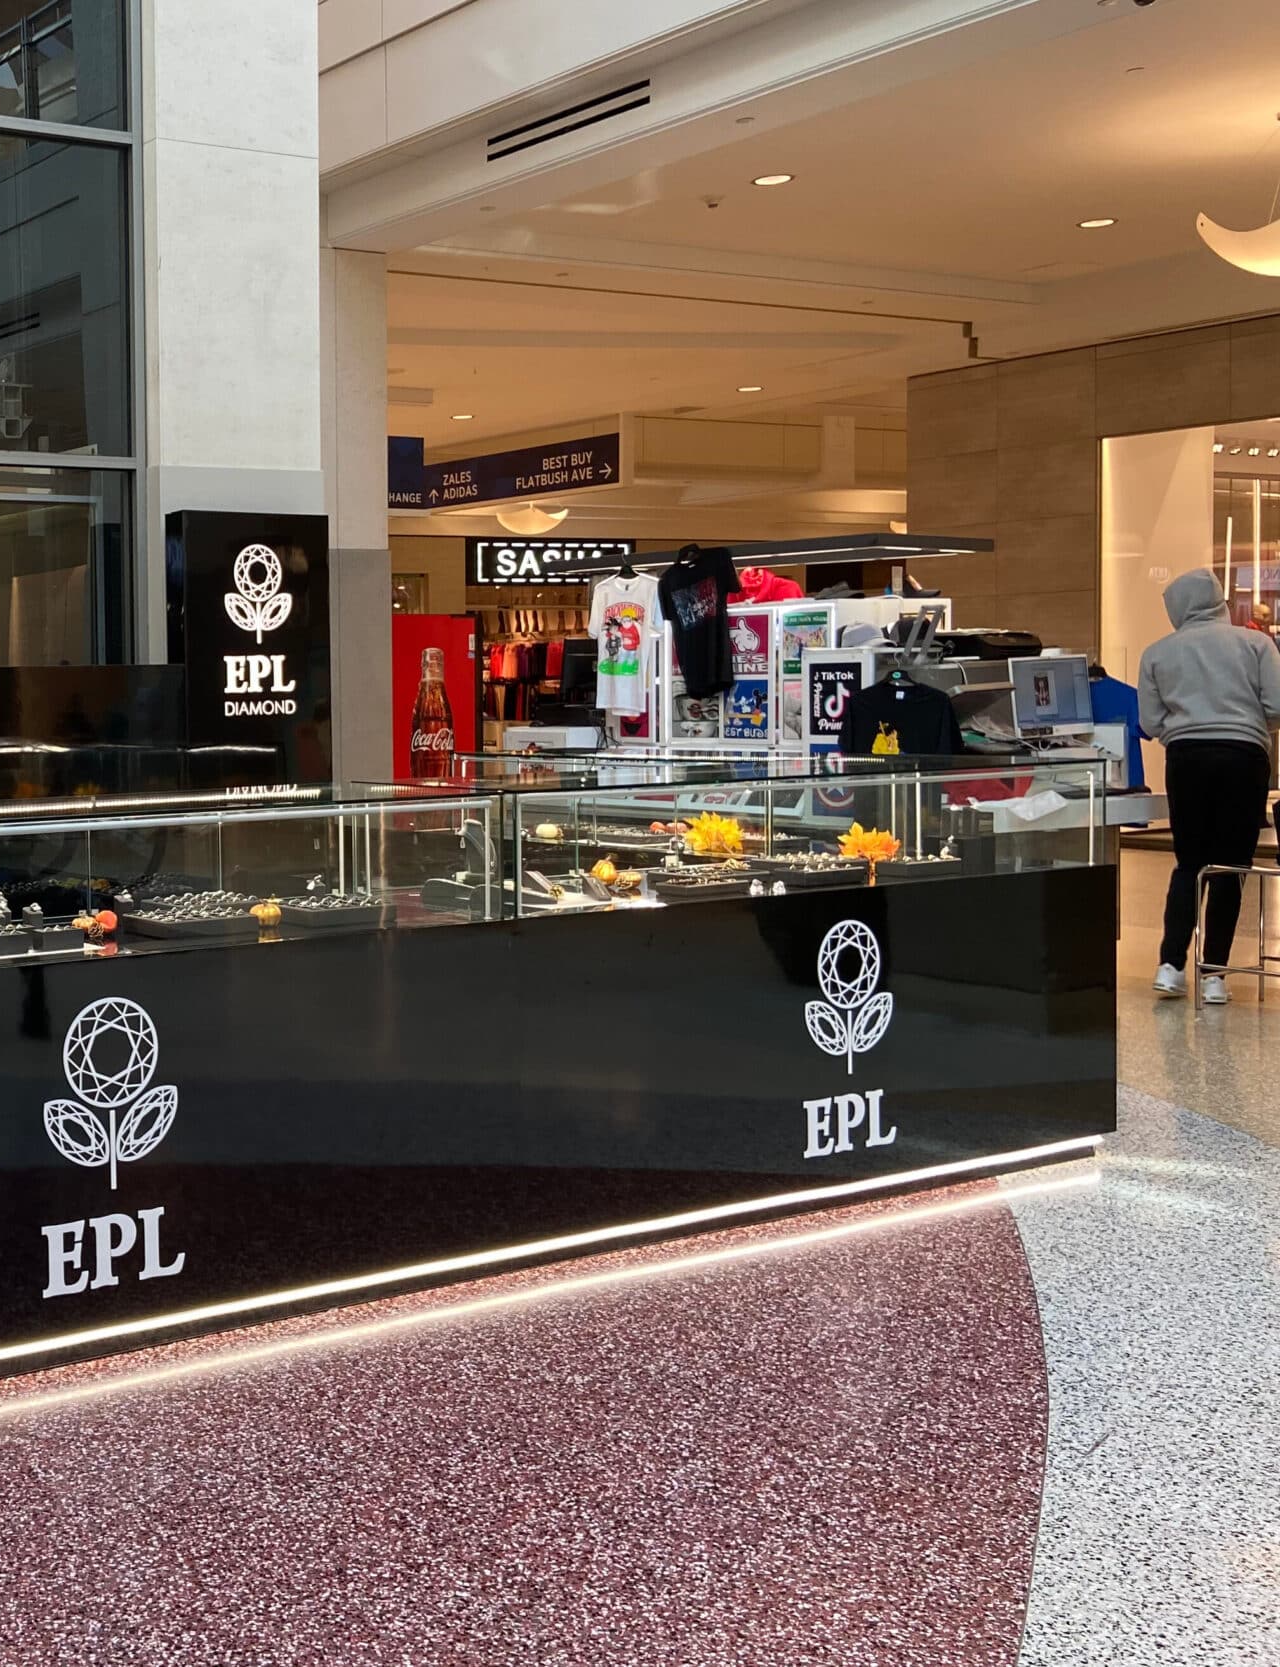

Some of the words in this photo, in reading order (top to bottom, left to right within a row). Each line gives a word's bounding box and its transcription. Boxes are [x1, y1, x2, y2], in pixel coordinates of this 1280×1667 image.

[542, 453, 568, 471] BEST
[570, 451, 593, 467] BUY
[442, 471, 472, 487] ZALES
[515, 469, 568, 490] FLATBUSH
[570, 466, 593, 481] AVE
[442, 484, 478, 501] ADIDAS
[224, 654, 296, 694] EPL
[821, 671, 854, 681] TikTok
[224, 699, 297, 716] DIAMOND
[410, 727, 454, 752] Coca-Cola
[802, 1088, 897, 1159] EPL
[41, 1206, 186, 1300] EPL
